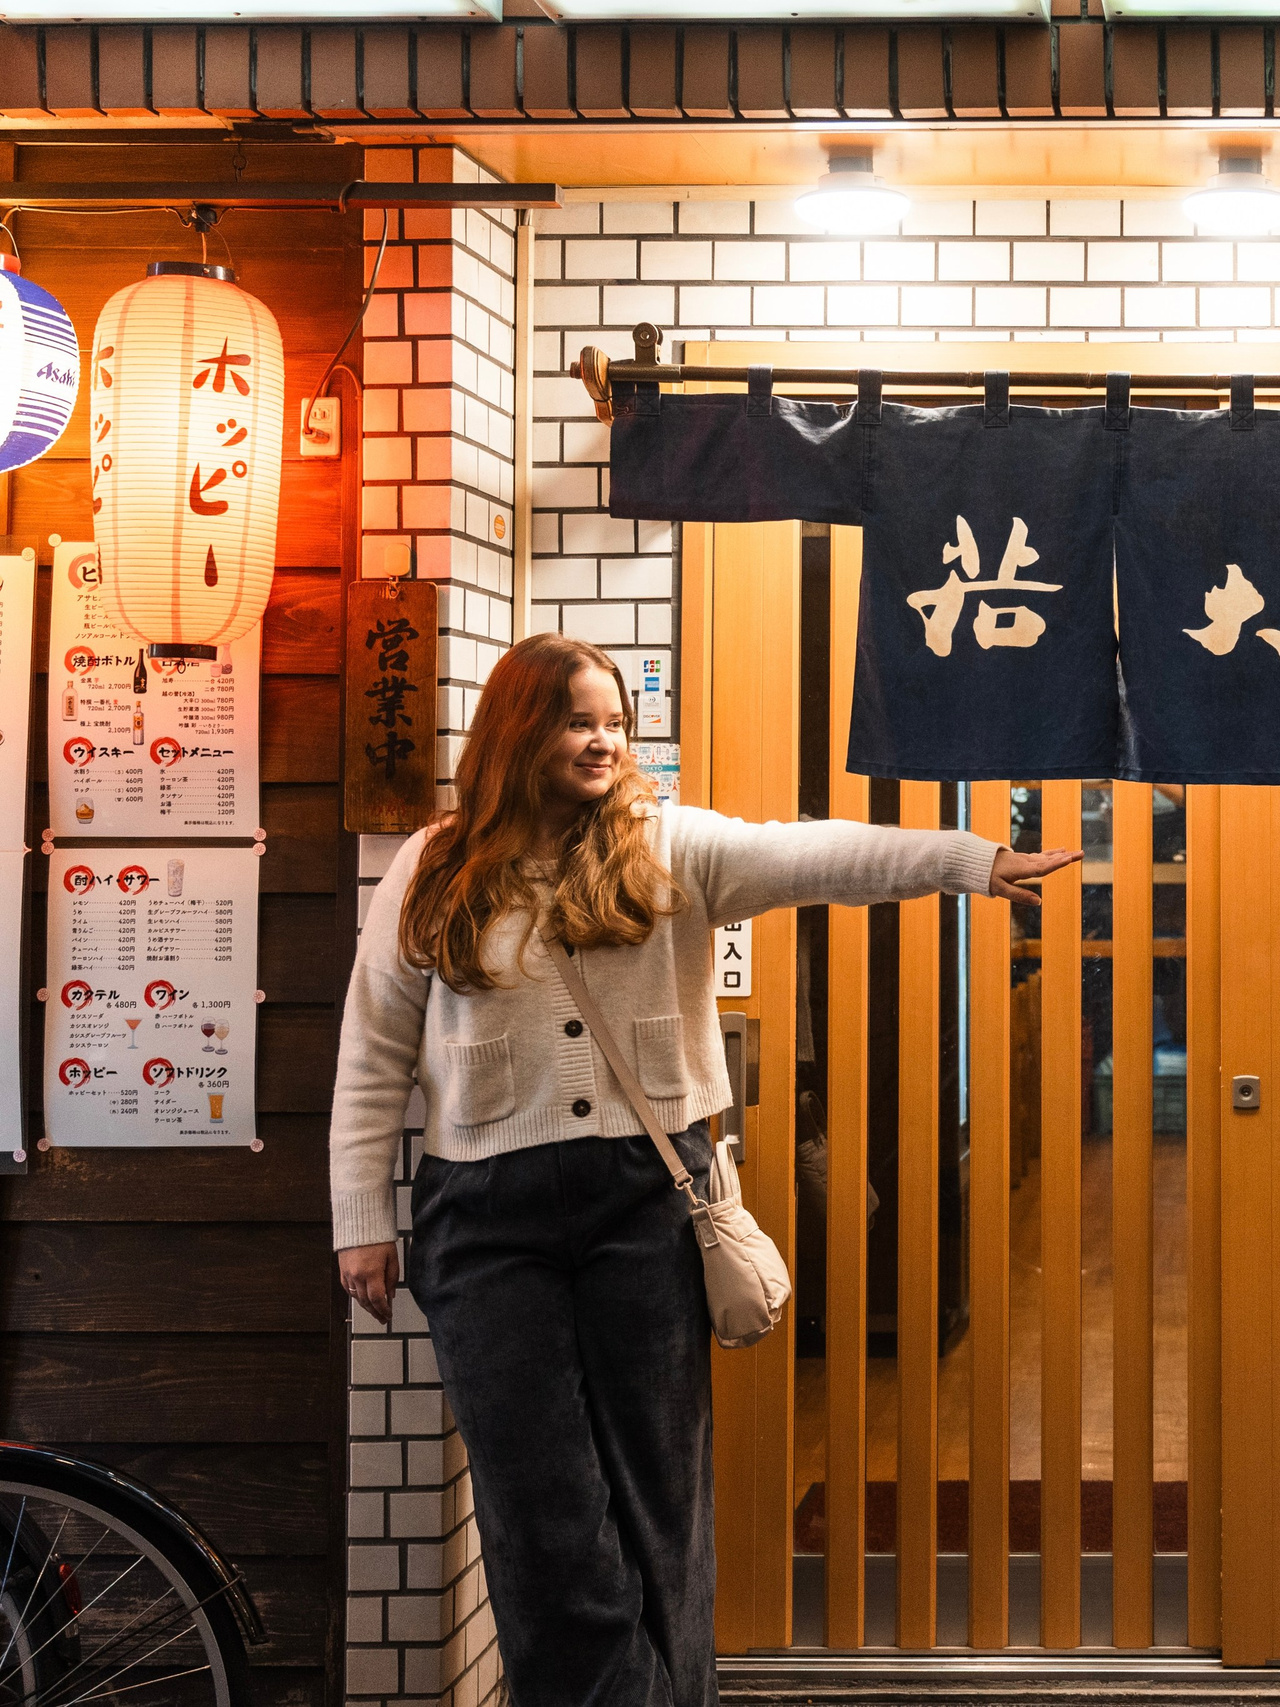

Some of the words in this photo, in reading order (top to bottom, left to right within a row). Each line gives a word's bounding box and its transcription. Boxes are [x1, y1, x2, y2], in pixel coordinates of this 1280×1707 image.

[36, 361, 76, 388] Asahi
[190, 336, 252, 587] ホッピー
[73, 655, 135, 667] 焼酎ボトル
[364, 618, 419, 780] 営業中
[73, 747, 135, 758] ウイスキー
[159, 747, 234, 758] セットメニュー
[74, 874, 160, 886] 酎ハイ・サワー
[71, 990, 120, 1001] カクテル
[156, 990, 189, 1000] ワイン
[69, 1067, 118, 1078] ホッピー
[153, 1067, 227, 1078] ソフトドリンク
[207, 1080, 229, 1088] 360円
